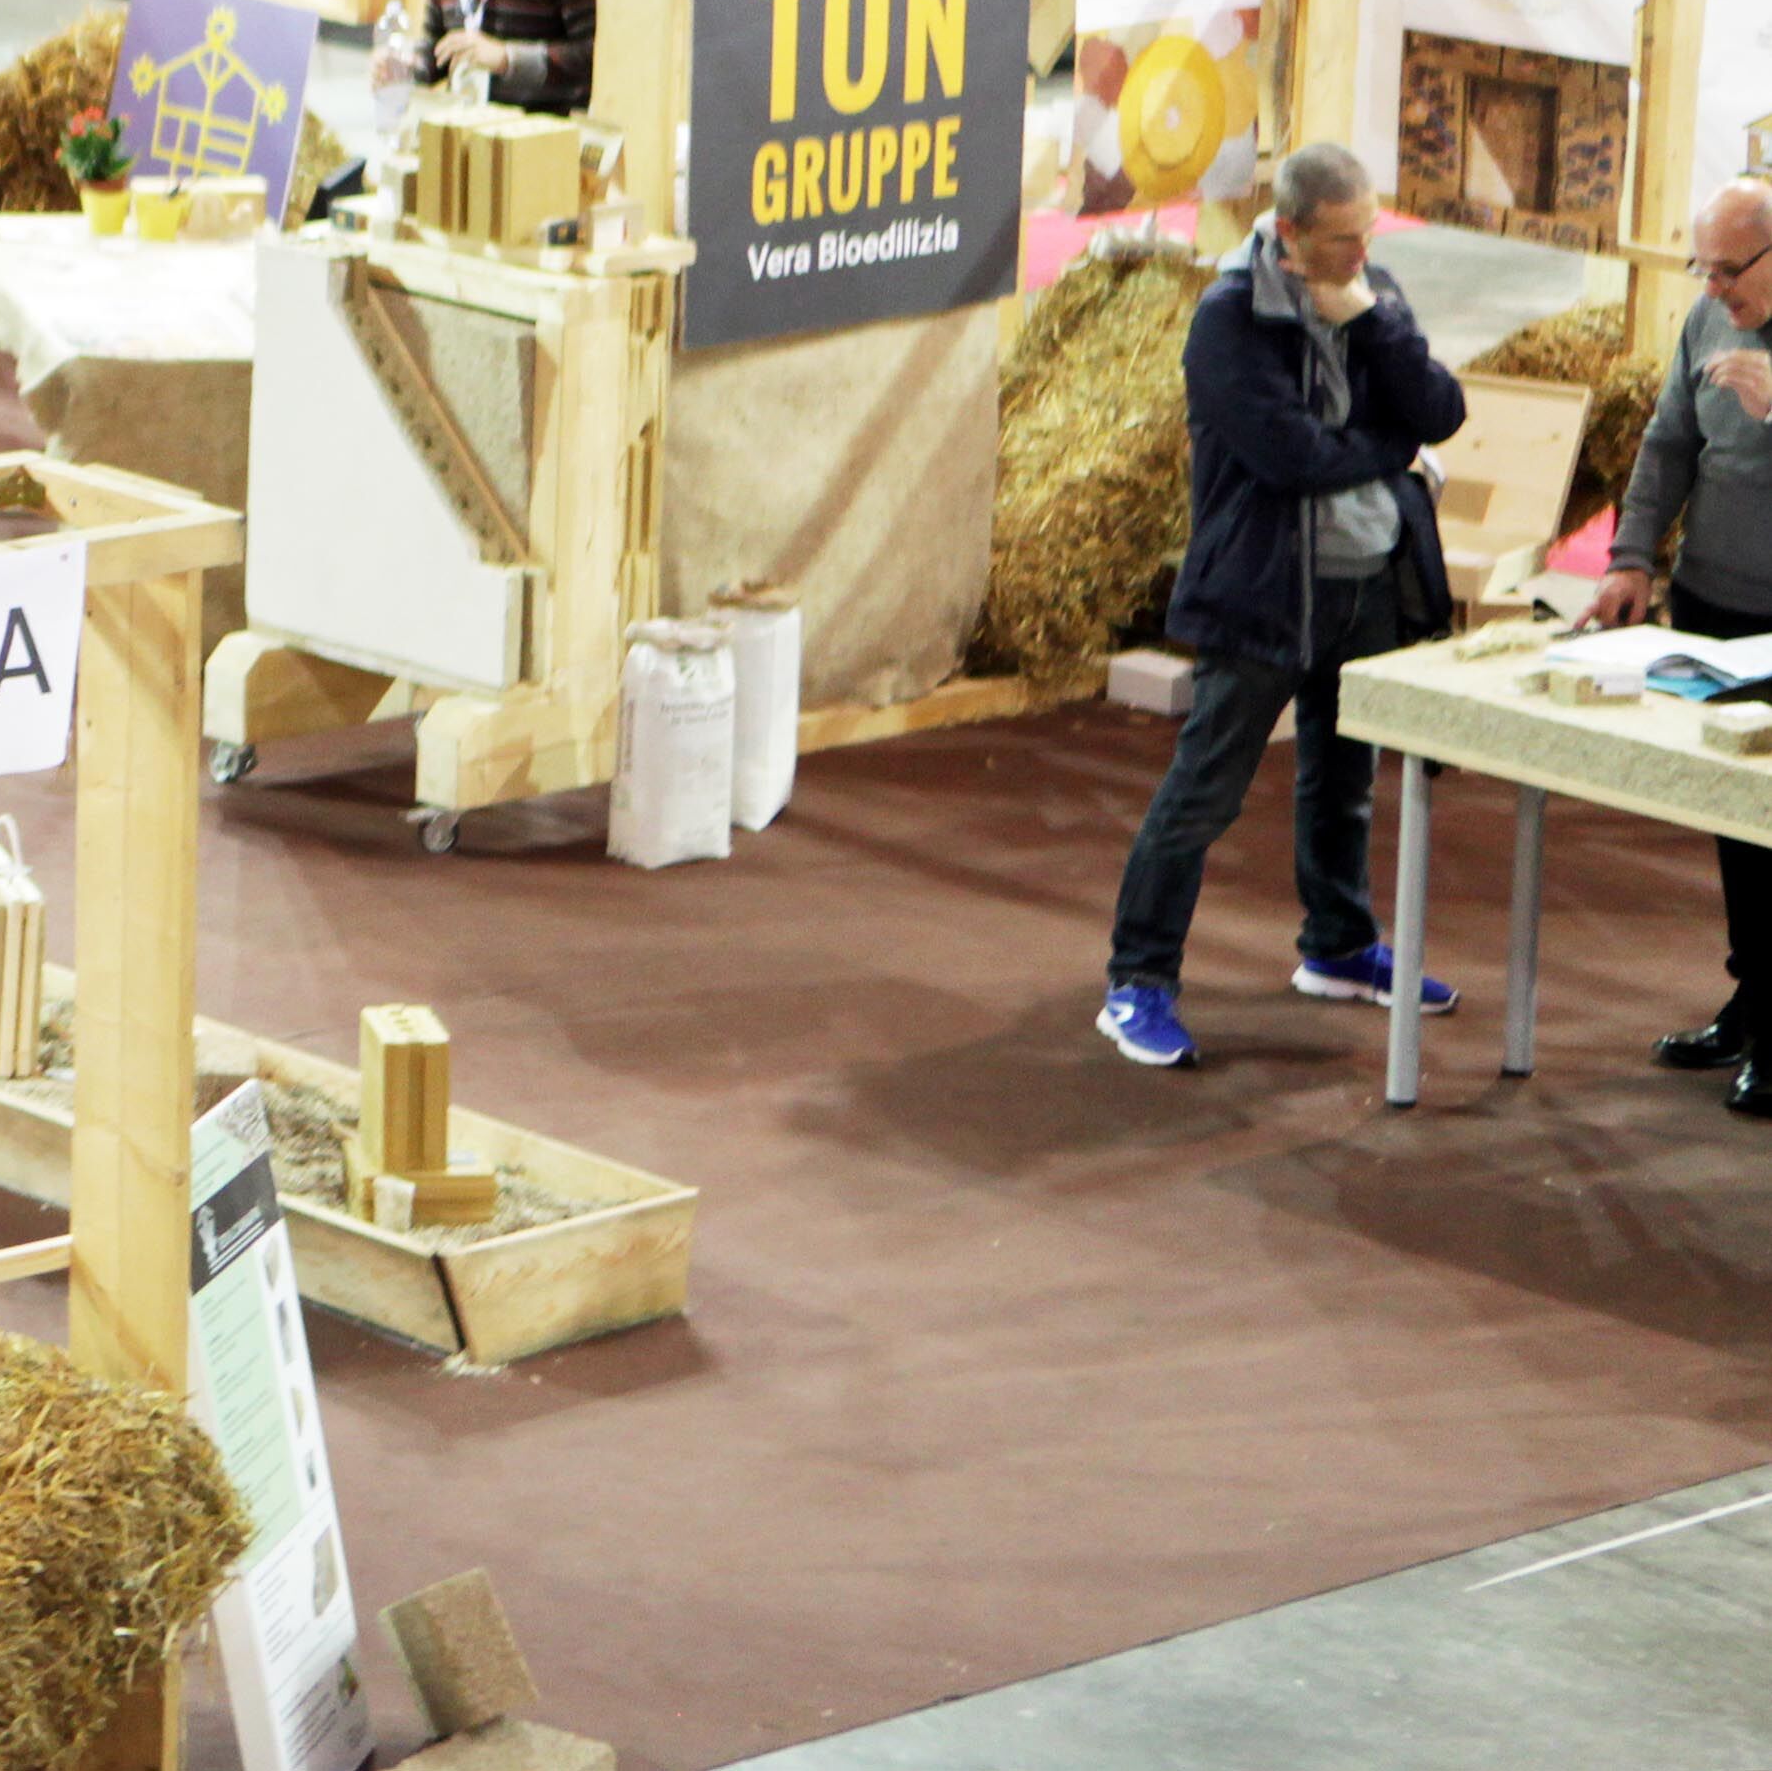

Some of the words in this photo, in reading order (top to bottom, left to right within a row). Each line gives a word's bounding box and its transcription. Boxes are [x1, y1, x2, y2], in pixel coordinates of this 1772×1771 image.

[750, 113, 962, 228] GRUPPE
[747, 239, 812, 282] Vera
[818, 212, 959, 272] Bioedilizia
